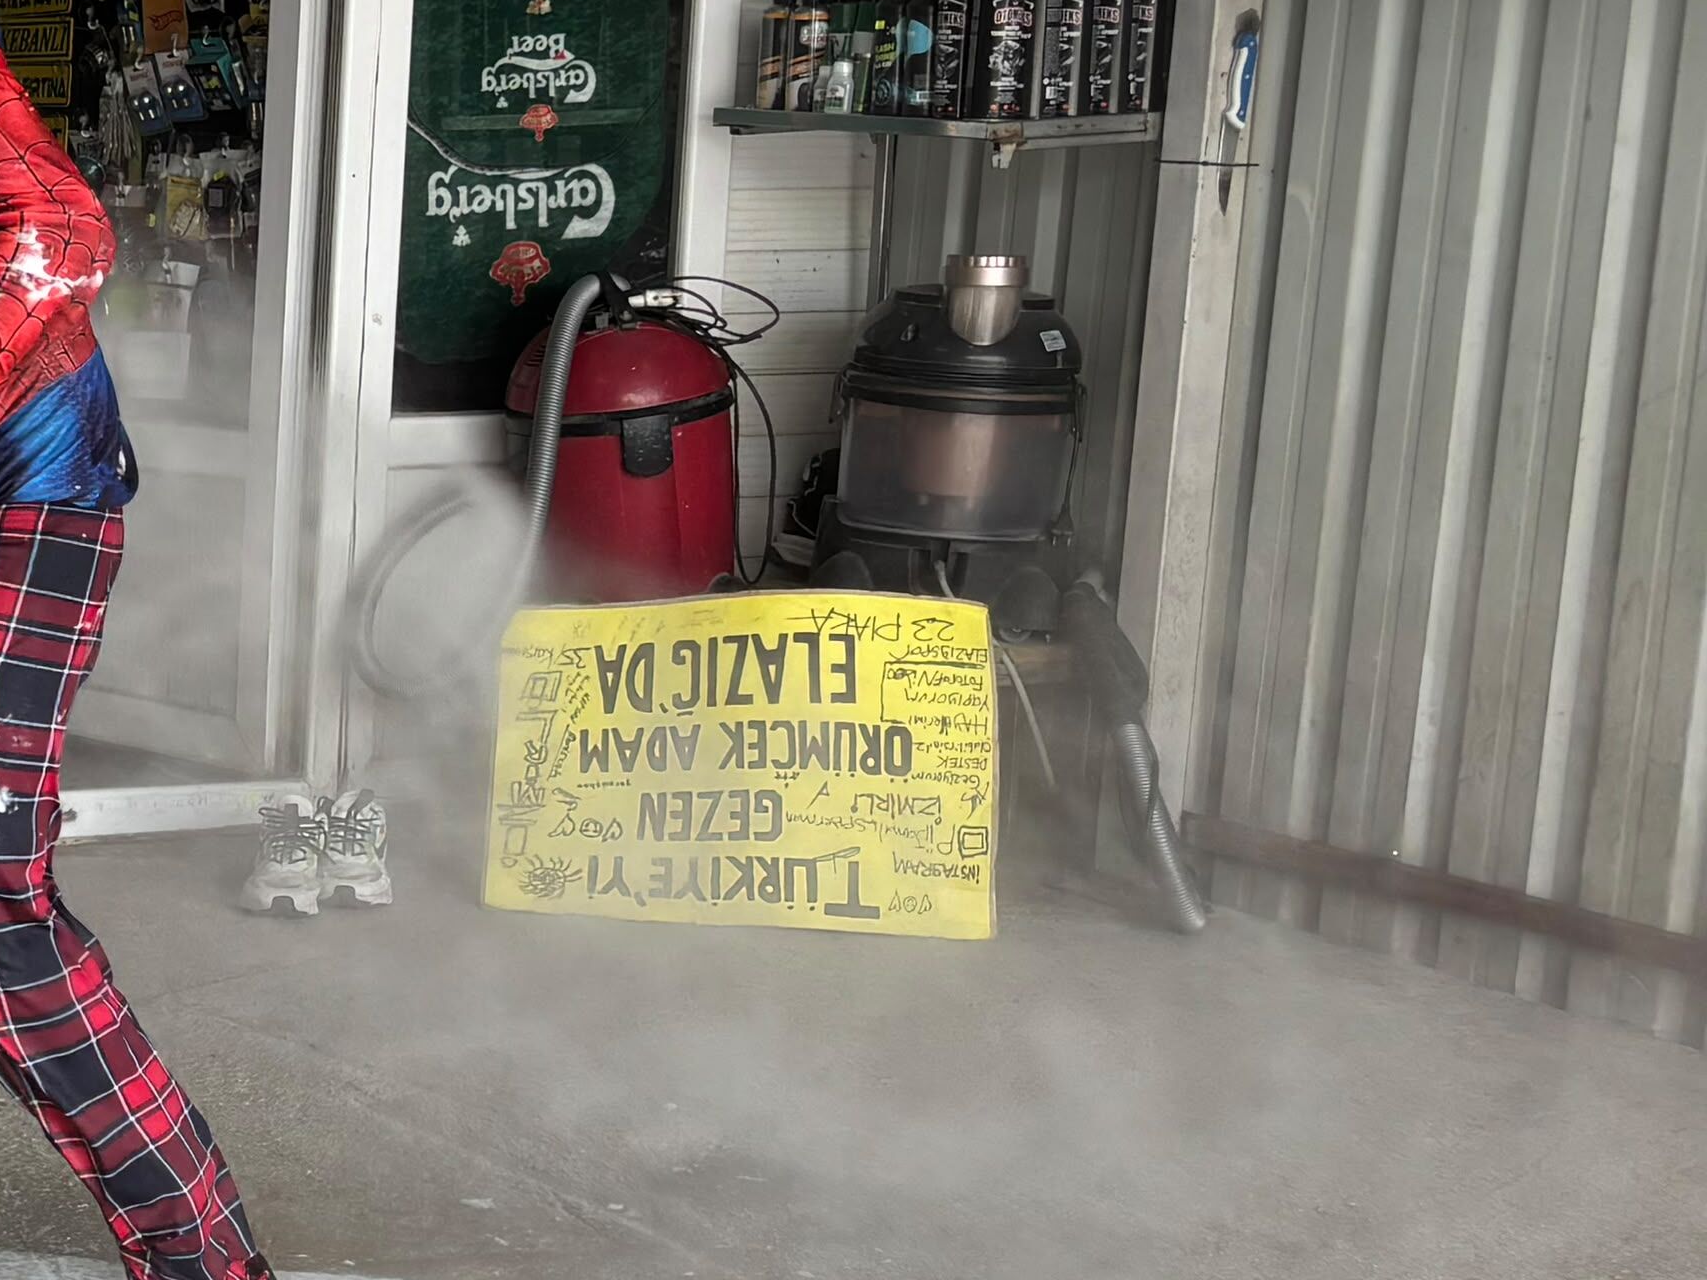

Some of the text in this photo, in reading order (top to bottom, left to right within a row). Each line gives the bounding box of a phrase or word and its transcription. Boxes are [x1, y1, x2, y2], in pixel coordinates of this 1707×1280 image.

[3, 27, 68, 54] KEBANLI
[507, 33, 568, 60] Beer
[481, 55, 598, 105] Carlsberg
[425, 163, 616, 240] Carlsberg
[911, 616, 955, 642] 23
[595, 632, 857, 718] ELAZIĞ'DA
[578, 724, 702, 775] ADAM
[937, 755, 988, 770] DESTEK
[637, 789, 783, 843] GEZEN
[584, 845, 881, 920] TÜRKİYE'Yİ
